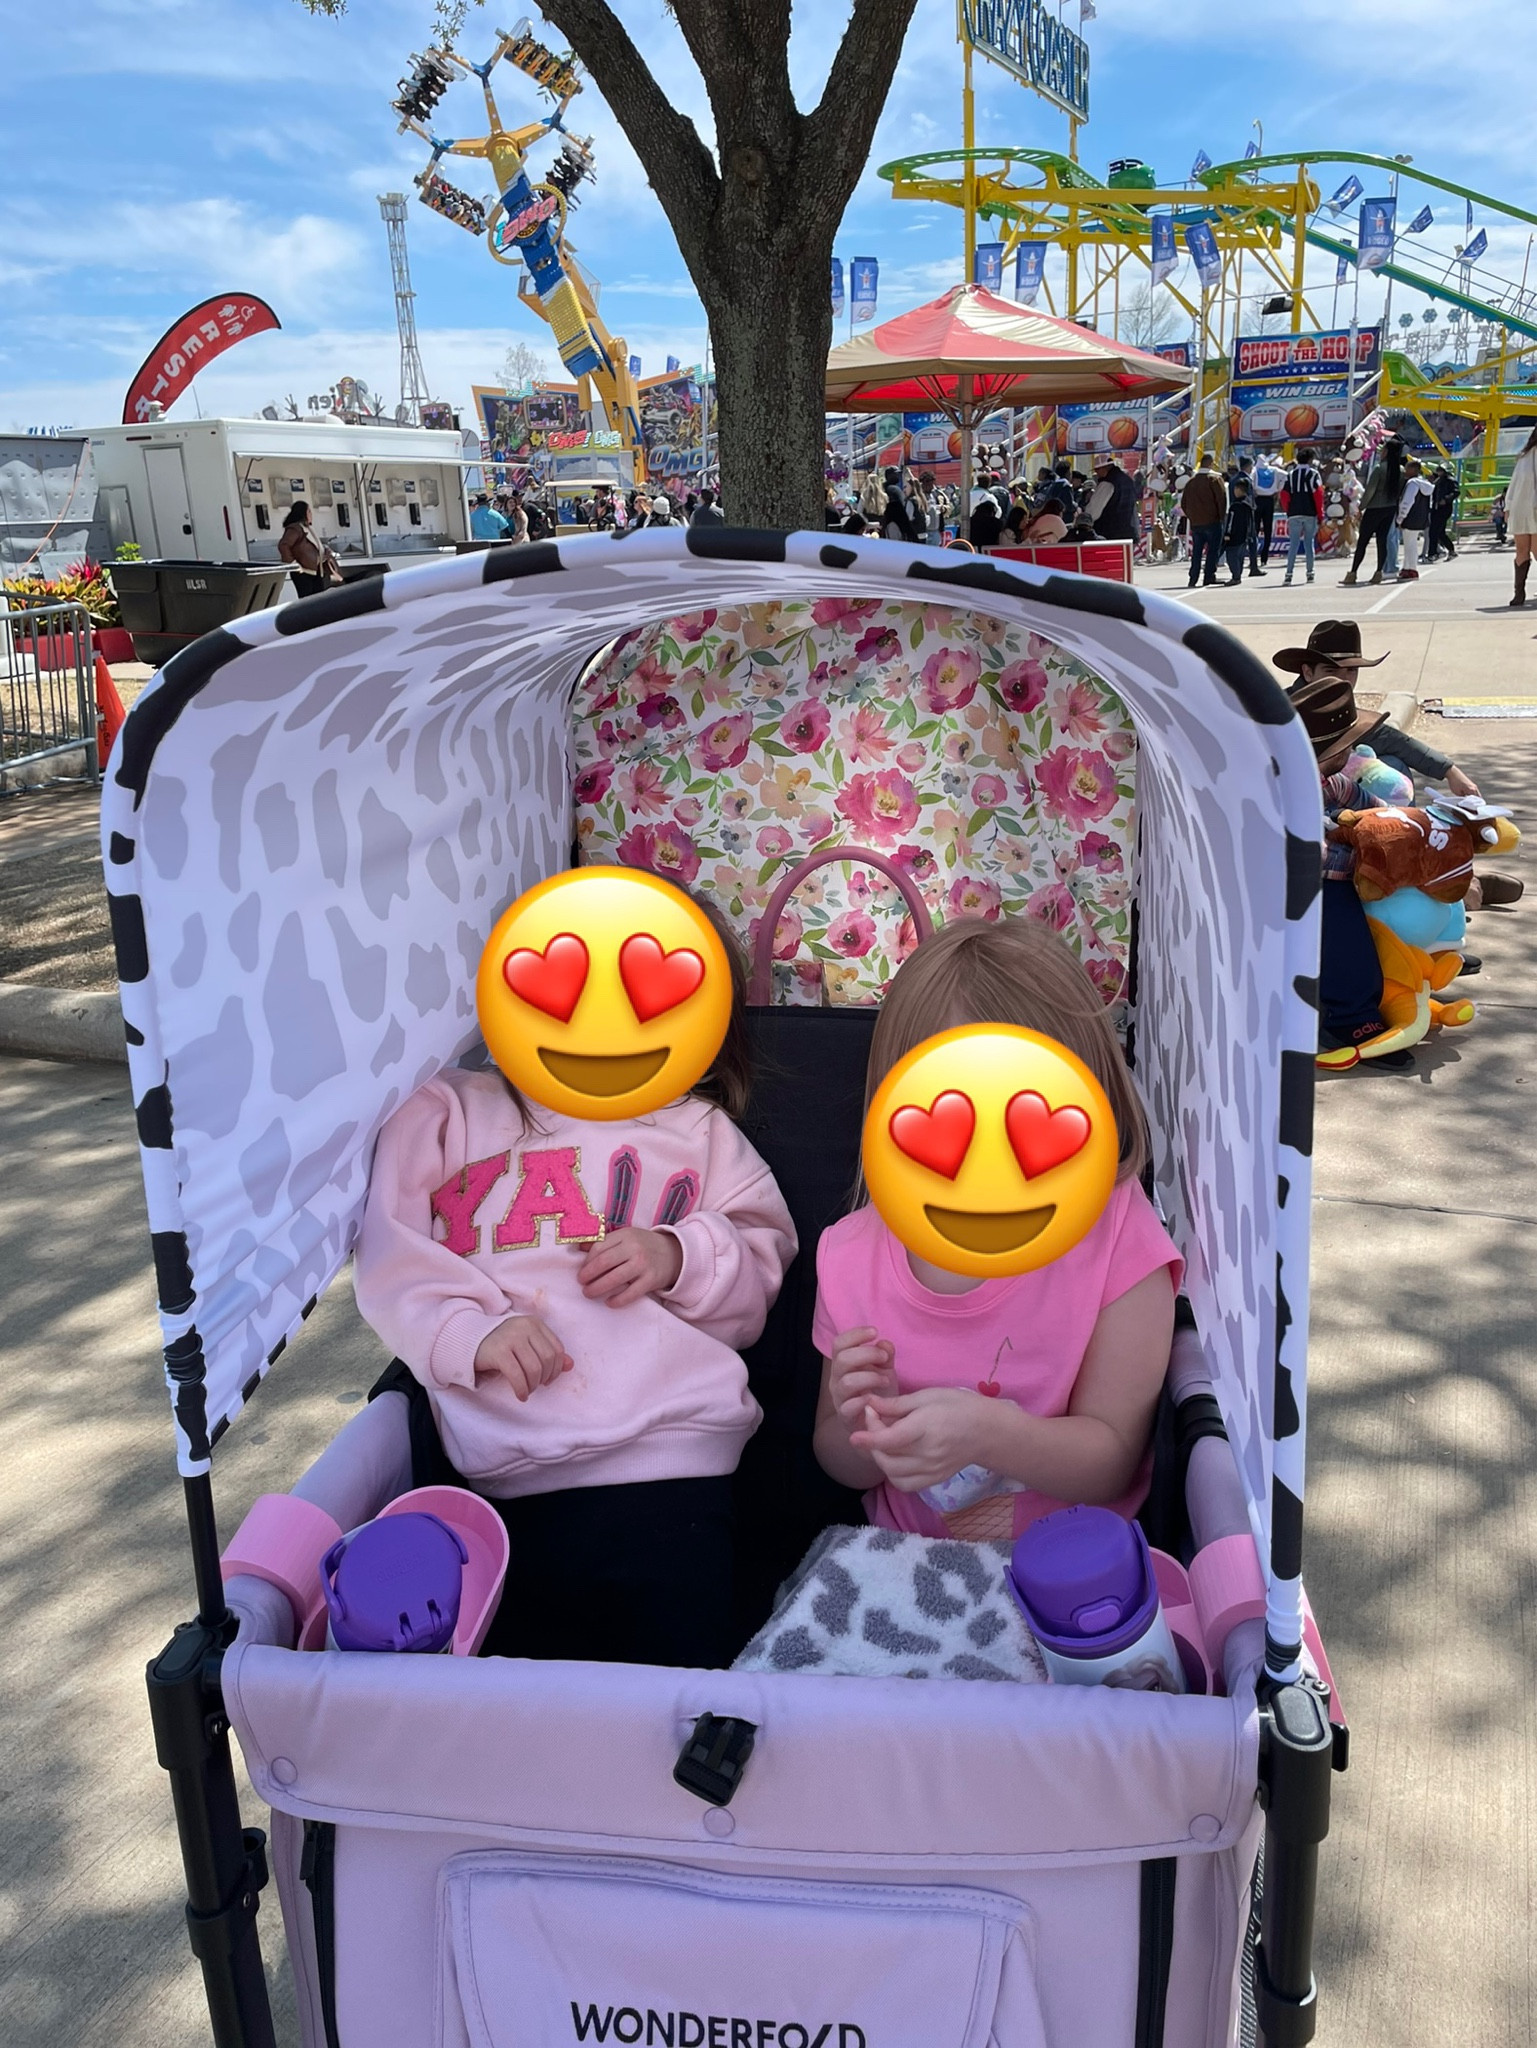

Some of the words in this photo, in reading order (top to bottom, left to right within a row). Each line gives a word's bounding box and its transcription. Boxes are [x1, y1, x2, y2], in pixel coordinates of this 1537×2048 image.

[1239, 340, 1290, 373] SHOOT
[1293, 347, 1318, 361] THE
[1265, 386, 1301, 399] WIN
[1303, 383, 1344, 396] BIG!
